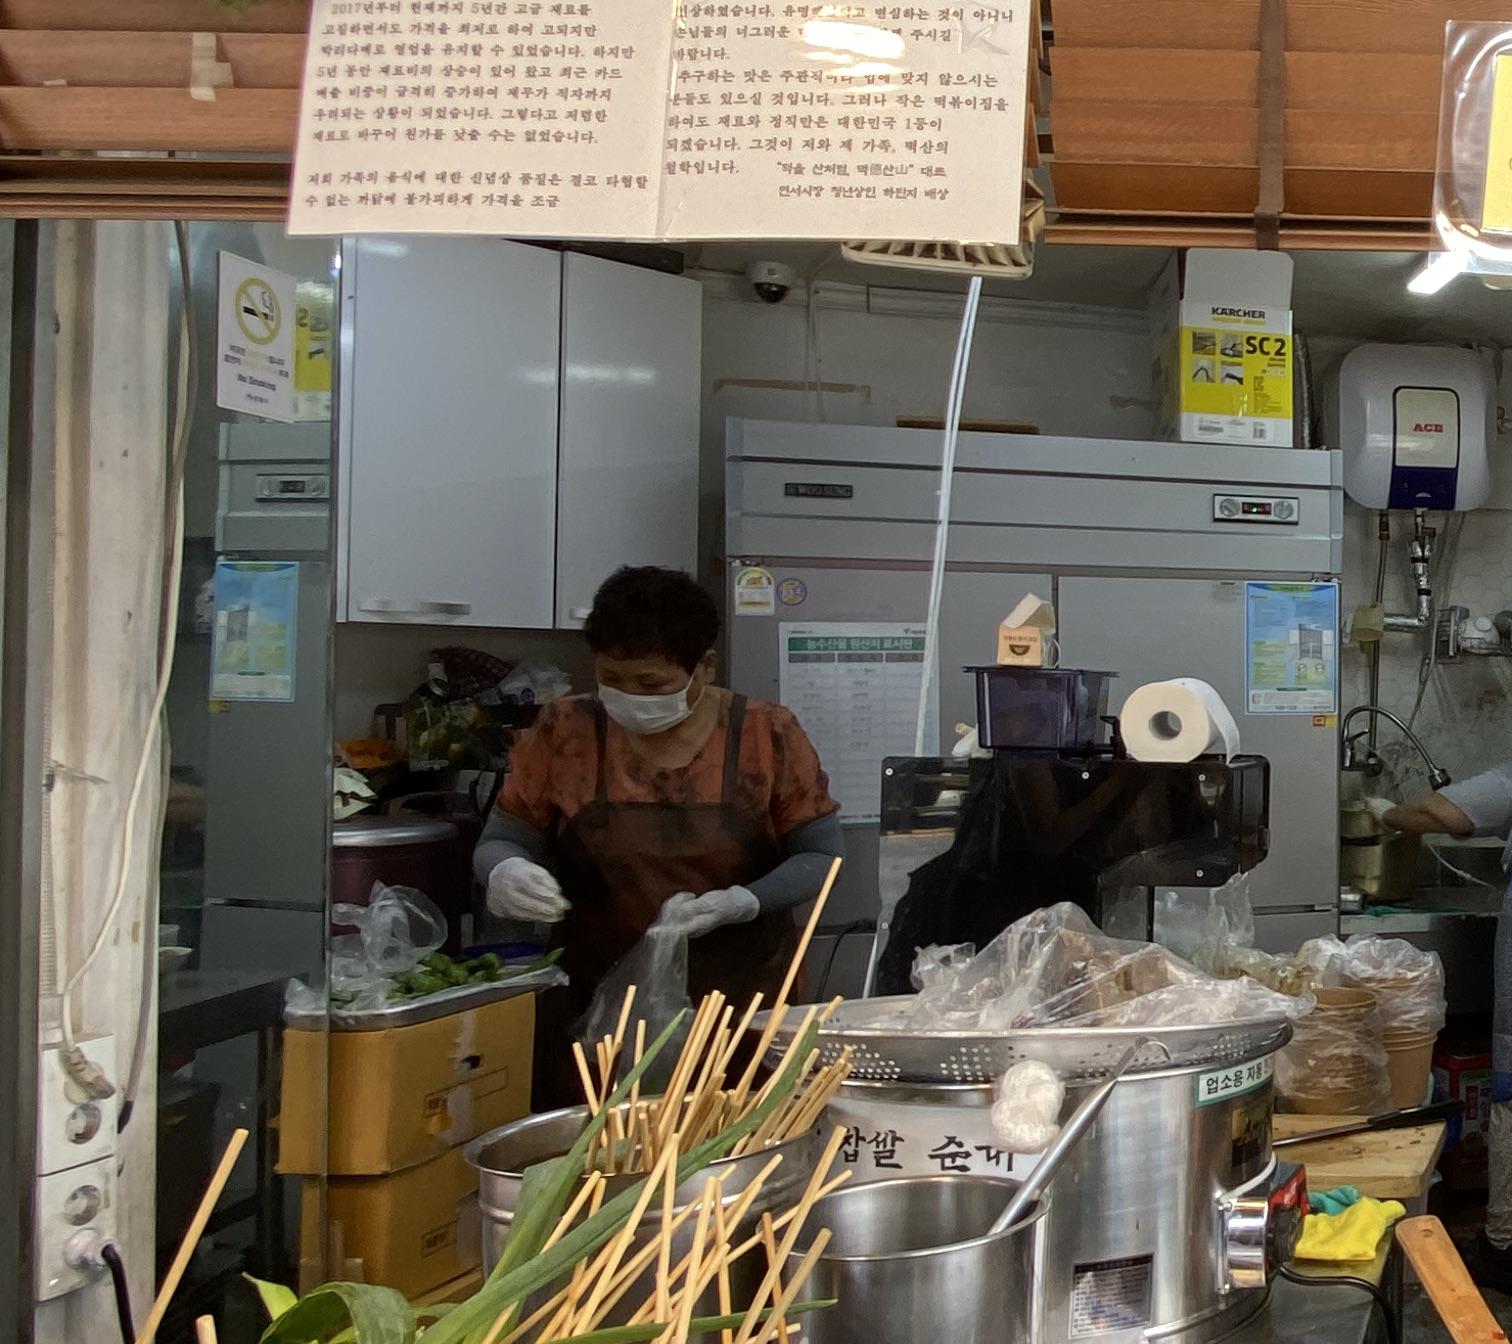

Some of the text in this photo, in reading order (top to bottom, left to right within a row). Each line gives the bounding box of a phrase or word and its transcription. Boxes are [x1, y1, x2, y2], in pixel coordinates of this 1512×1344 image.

[514, 3, 542, 15] 고급
[409, 23, 450, 35] 가격을
[508, 24, 534, 36] 하여
[490, 44, 505, 56] 수
[744, 69, 771, 83] 맛은
[720, 92, 763, 105] 있으실
[771, 92, 834, 106] 것입니다.
[842, 94, 886, 107] 그러나
[837, 116, 896, 130] 대한민국
[1245, 336, 1286, 356] SC 2
[1413, 424, 1443, 432] ACE
[1207, 1070, 1243, 1095] 업소용
